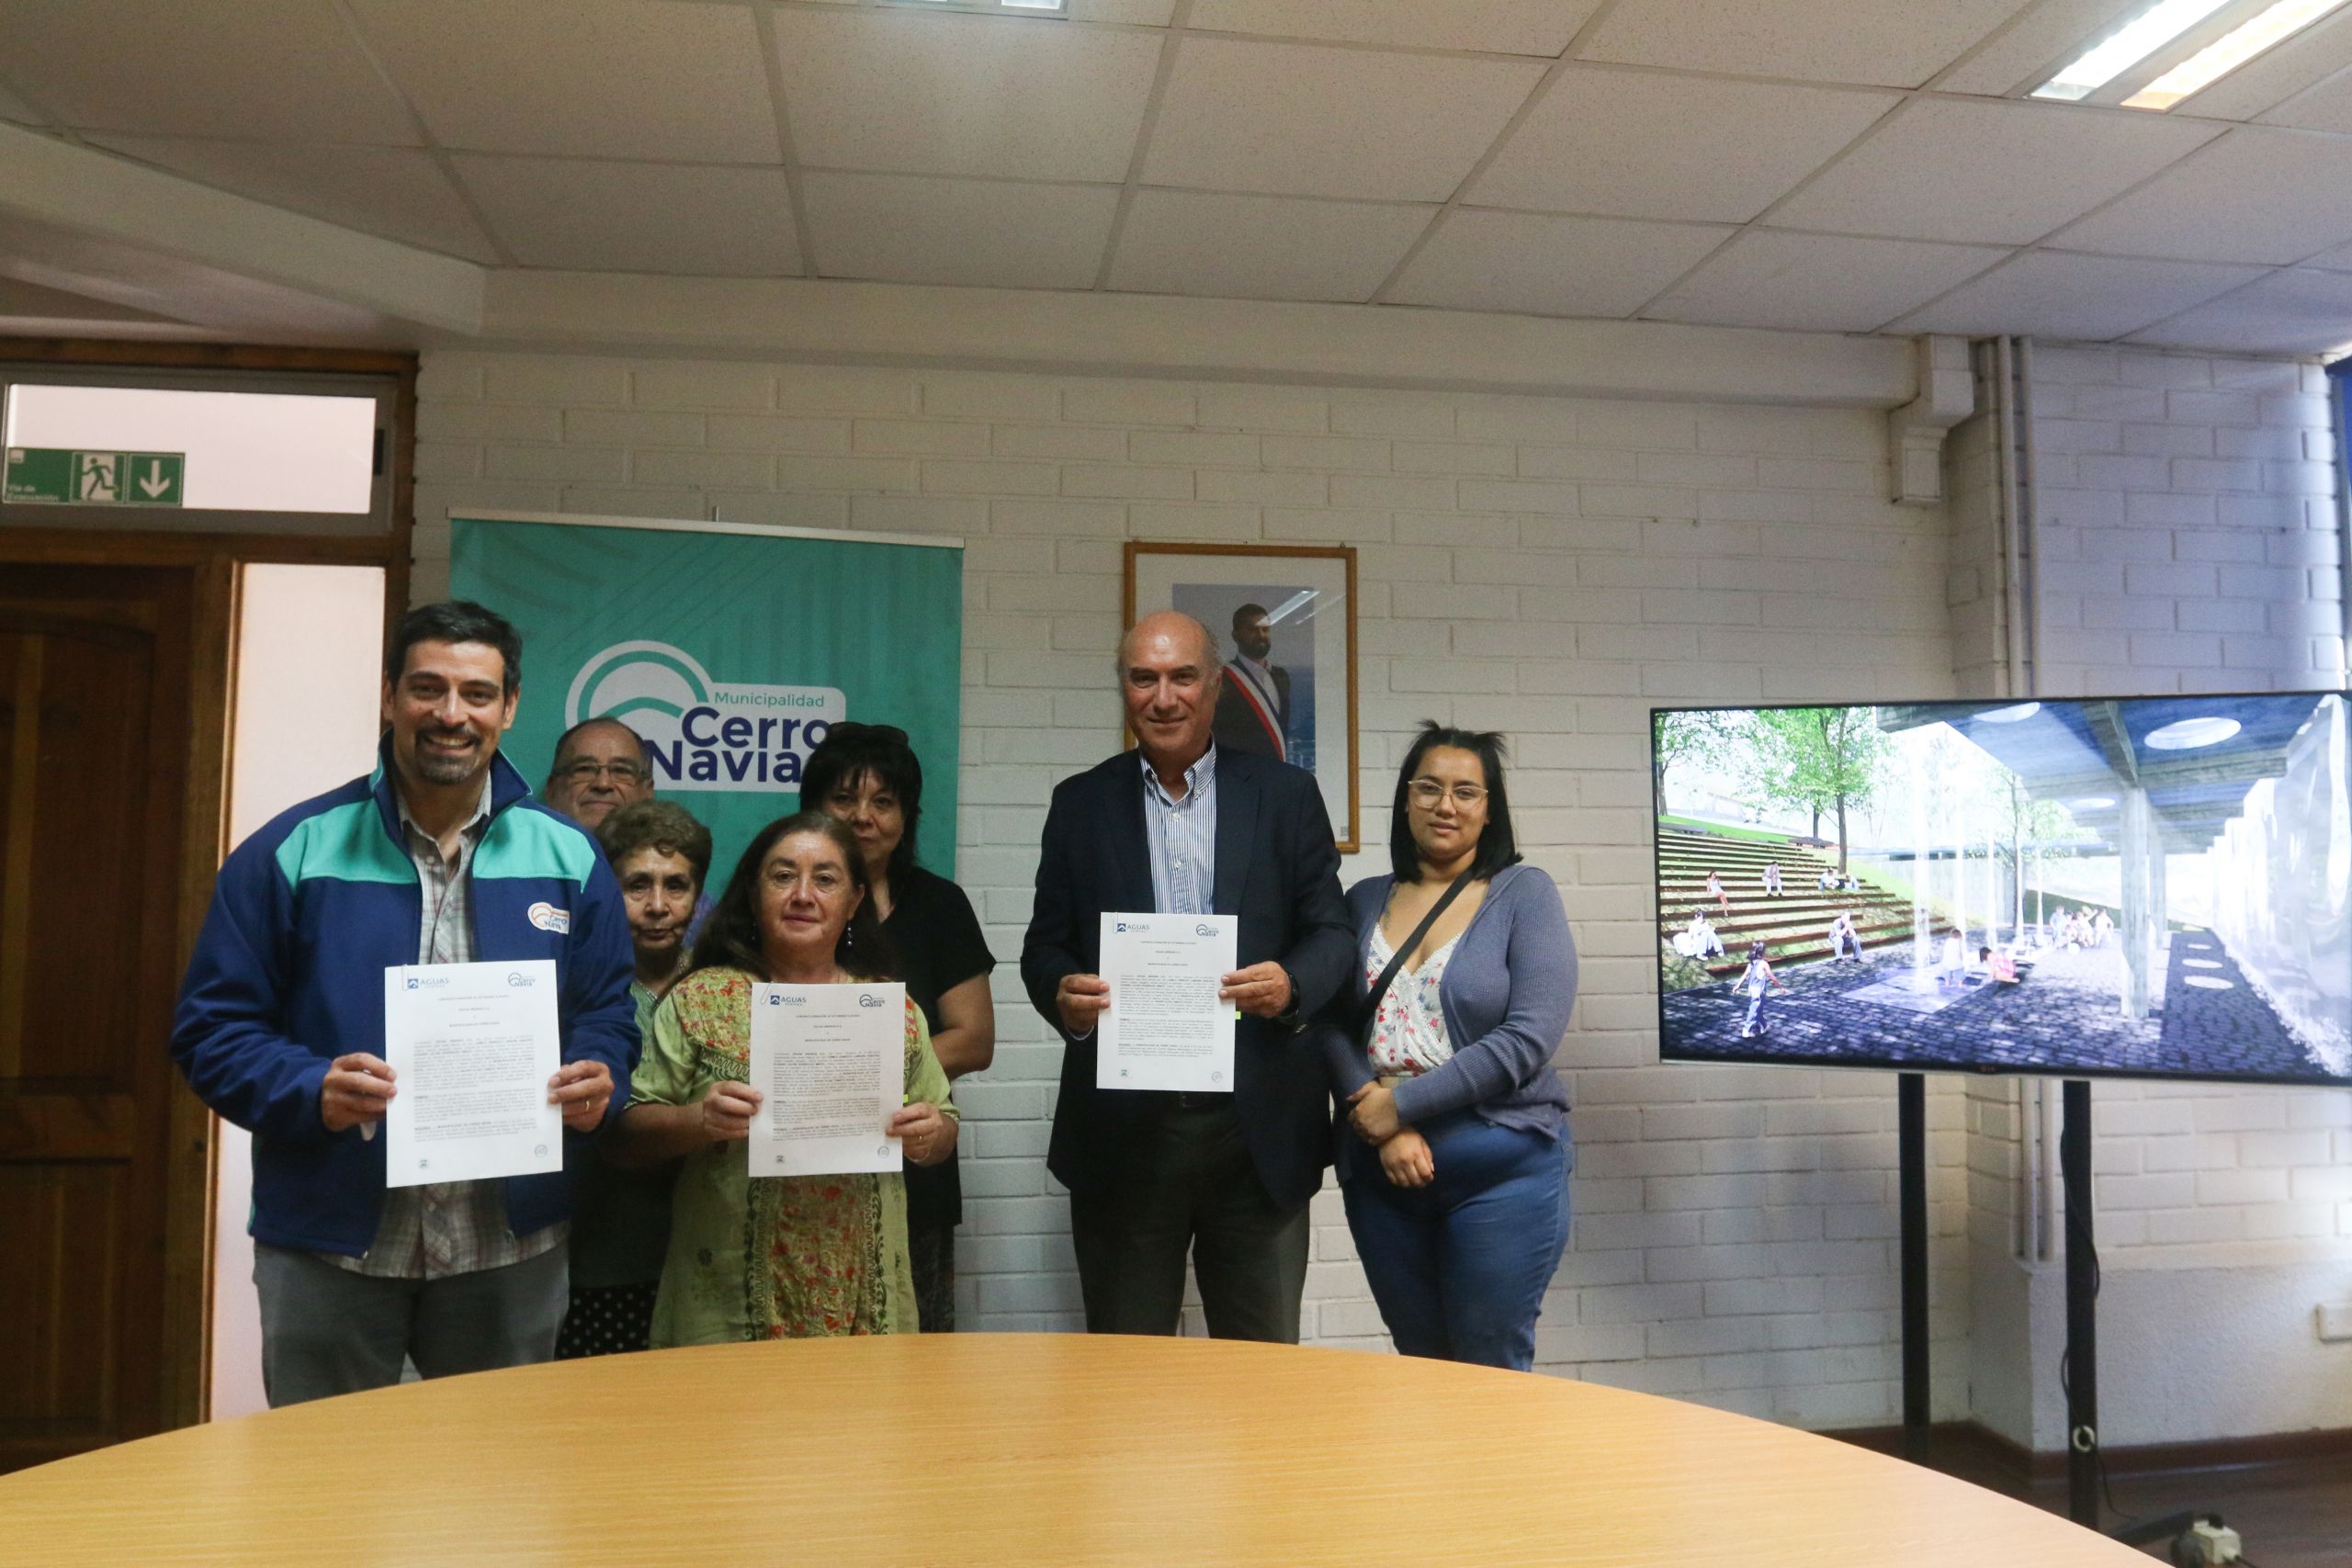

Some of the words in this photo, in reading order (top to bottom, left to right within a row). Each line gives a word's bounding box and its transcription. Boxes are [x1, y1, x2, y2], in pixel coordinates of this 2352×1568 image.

[715, 692, 825, 708] Municipalidad
[682, 706, 831, 750] Cerro
[643, 739, 802, 784] Navia
[420, 977, 449, 986] AGUAS
